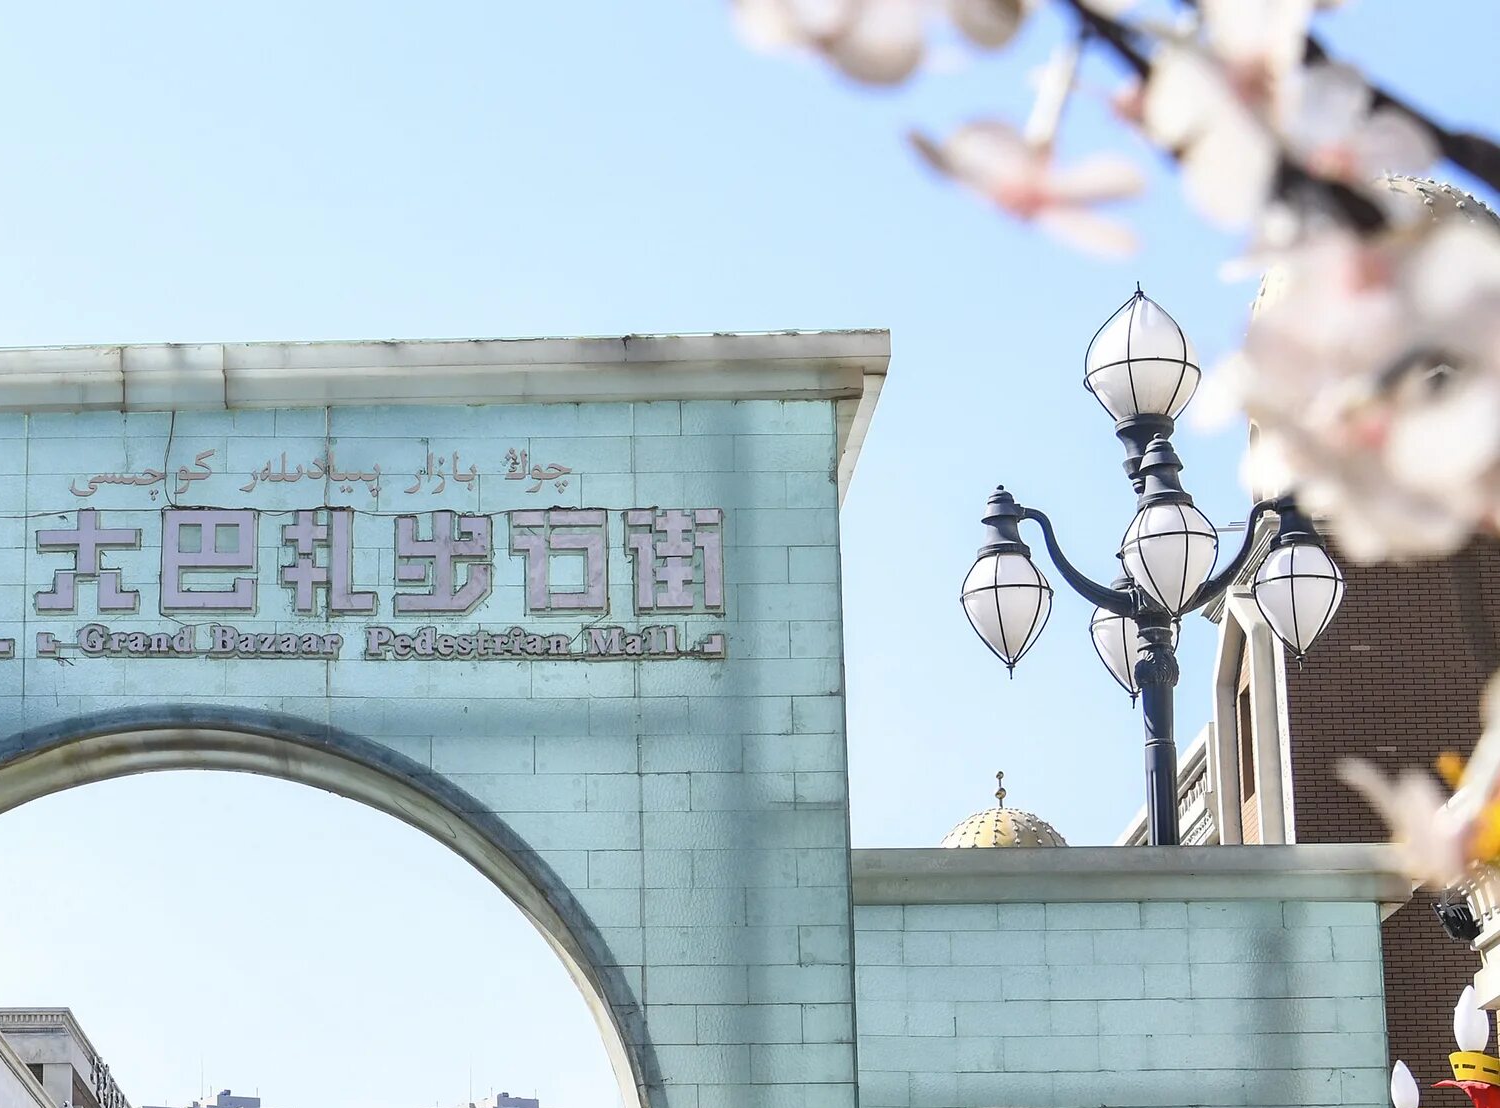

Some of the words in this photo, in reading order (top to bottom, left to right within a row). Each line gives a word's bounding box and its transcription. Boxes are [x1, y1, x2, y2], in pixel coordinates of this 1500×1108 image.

[403, 450, 478, 495] بازار
[35, 508, 725, 617] 大巴扎步行街
[78, 623, 196, 658] Grand
[210, 625, 343, 658] Bazaar
[365, 626, 570, 659] Pedestrian
[587, 625, 680, 659] Mall
